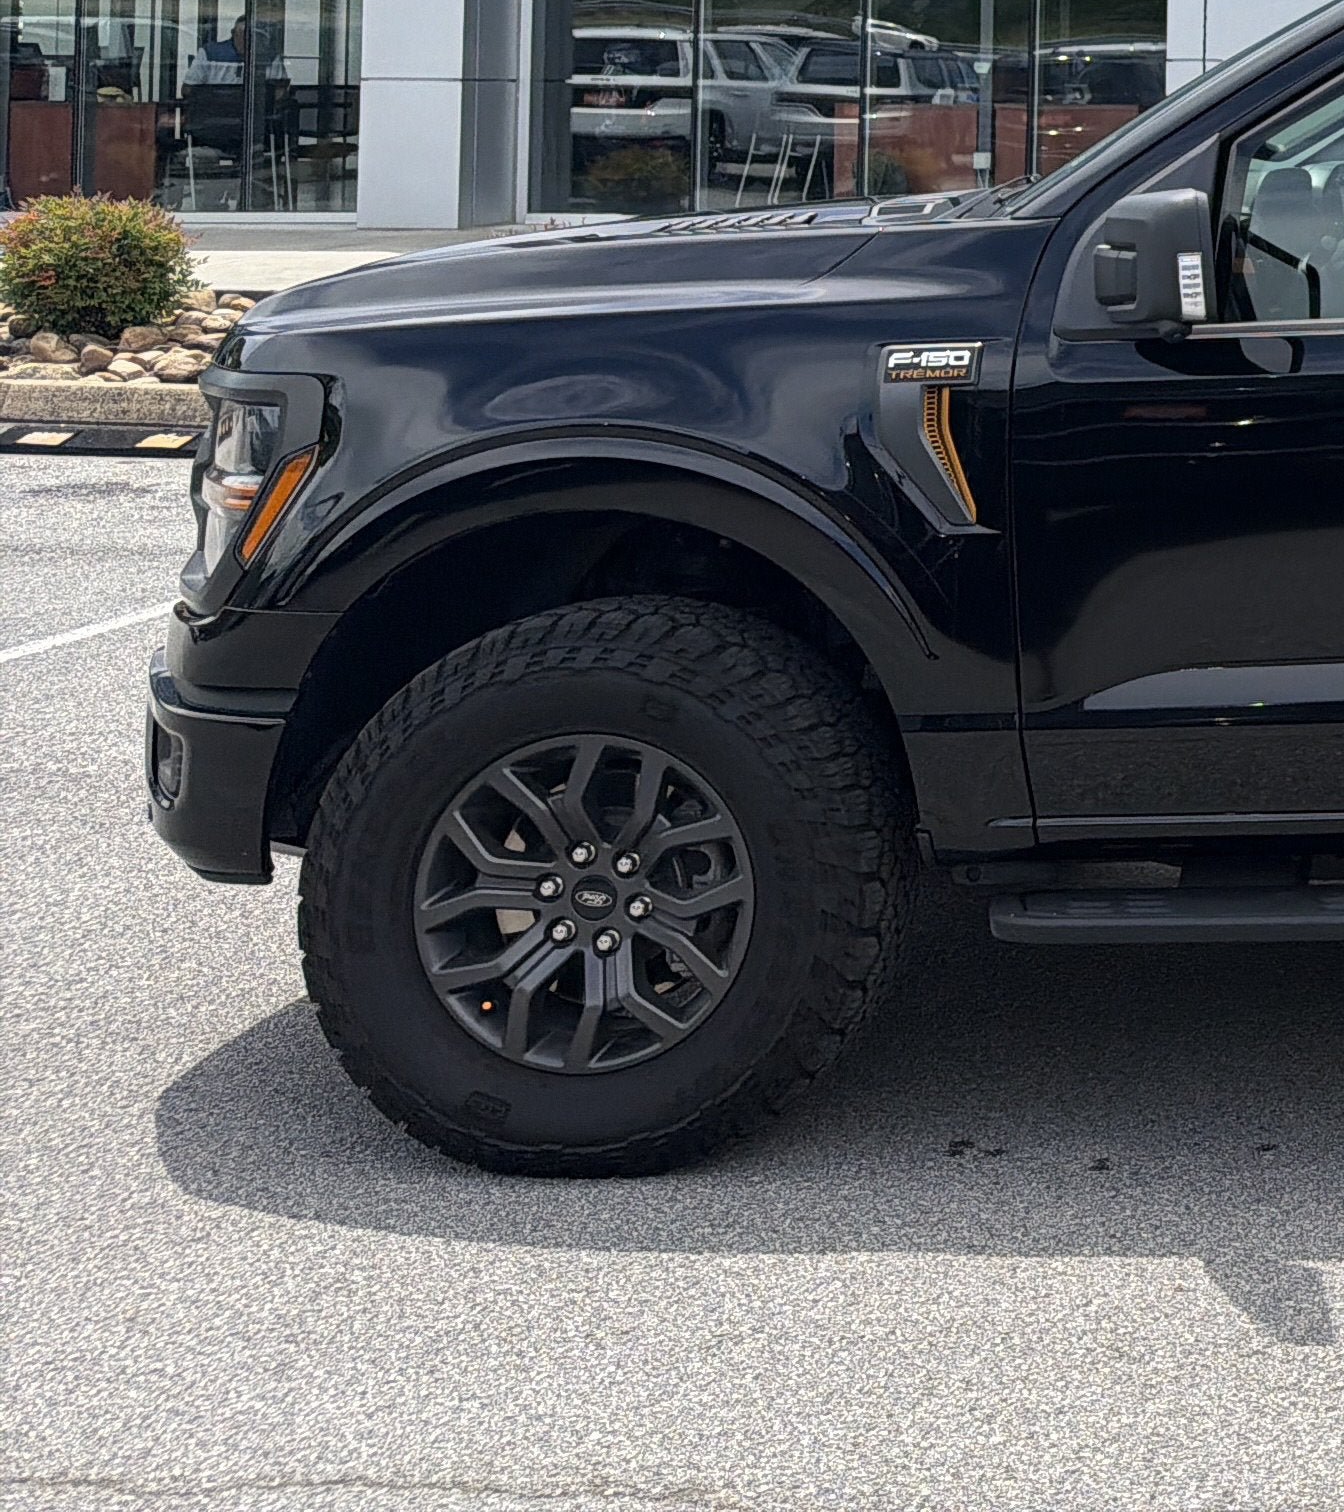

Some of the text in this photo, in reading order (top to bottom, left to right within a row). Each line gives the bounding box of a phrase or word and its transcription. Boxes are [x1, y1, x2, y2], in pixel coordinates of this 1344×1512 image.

[887, 349, 972, 368] F-150
[888, 368, 967, 380] TREMOR
[579, 892, 608, 906] Ford
